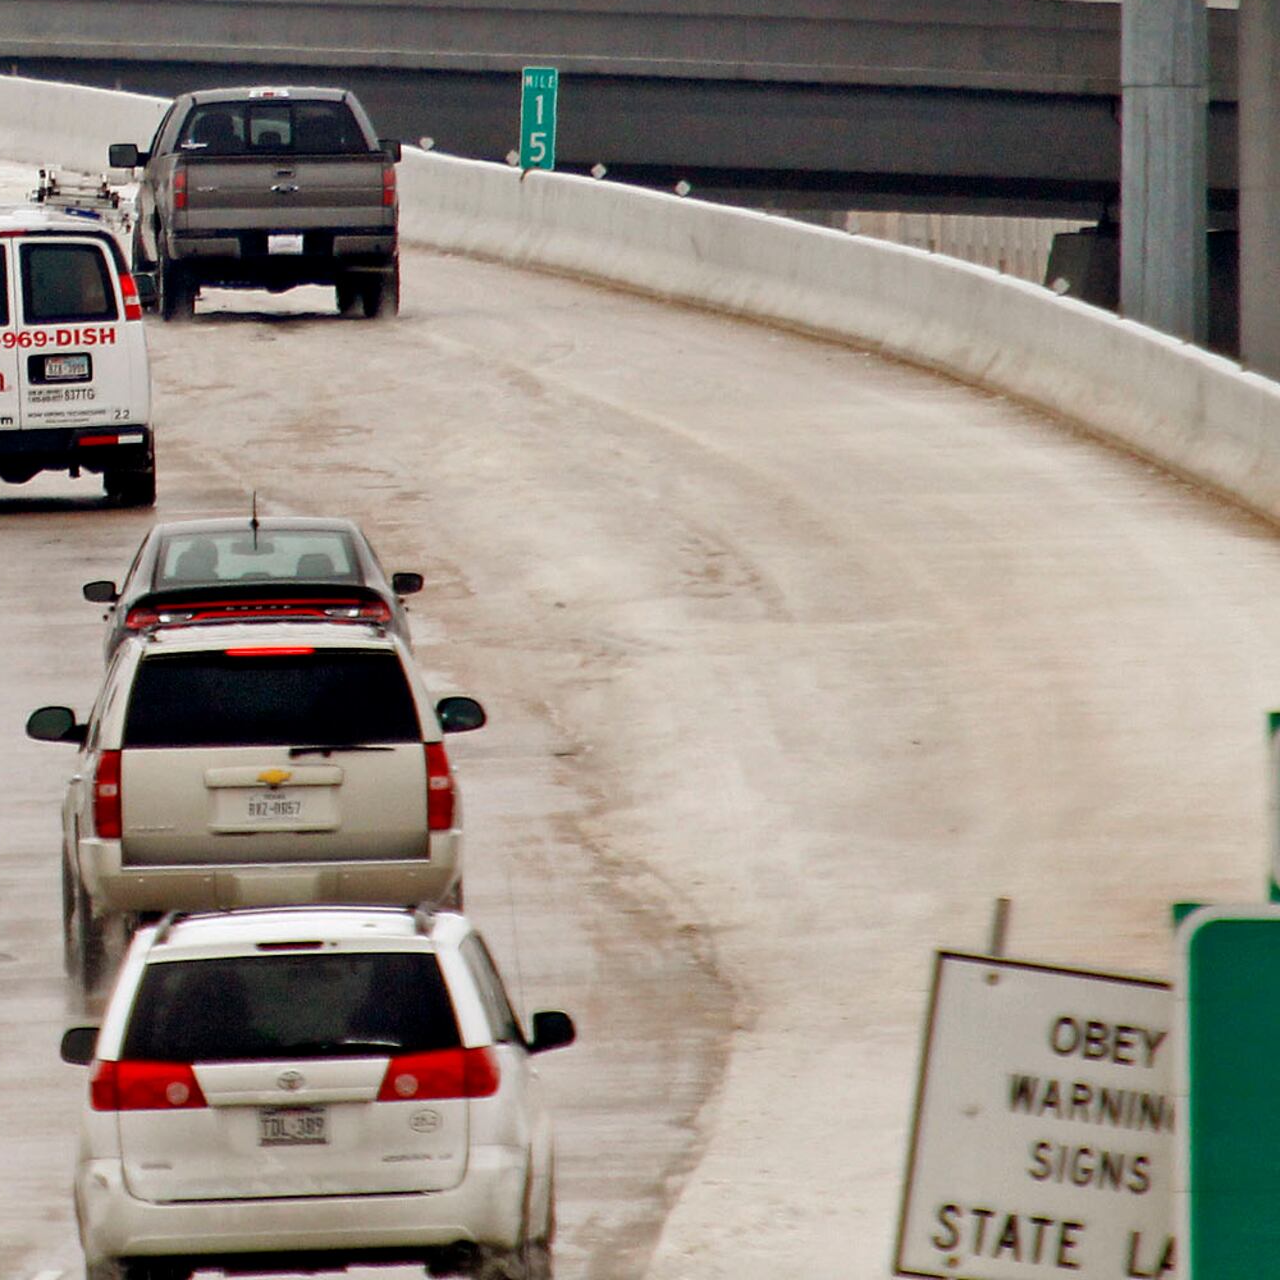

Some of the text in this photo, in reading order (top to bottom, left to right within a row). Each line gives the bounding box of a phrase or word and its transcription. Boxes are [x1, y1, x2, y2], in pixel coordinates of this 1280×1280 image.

[1049, 1015, 1168, 1069] OBEY
[1009, 1072, 1176, 1135] WARNIN
[1028, 1140, 1152, 1196] SIGNS
[931, 1203, 1086, 1270] STATE
